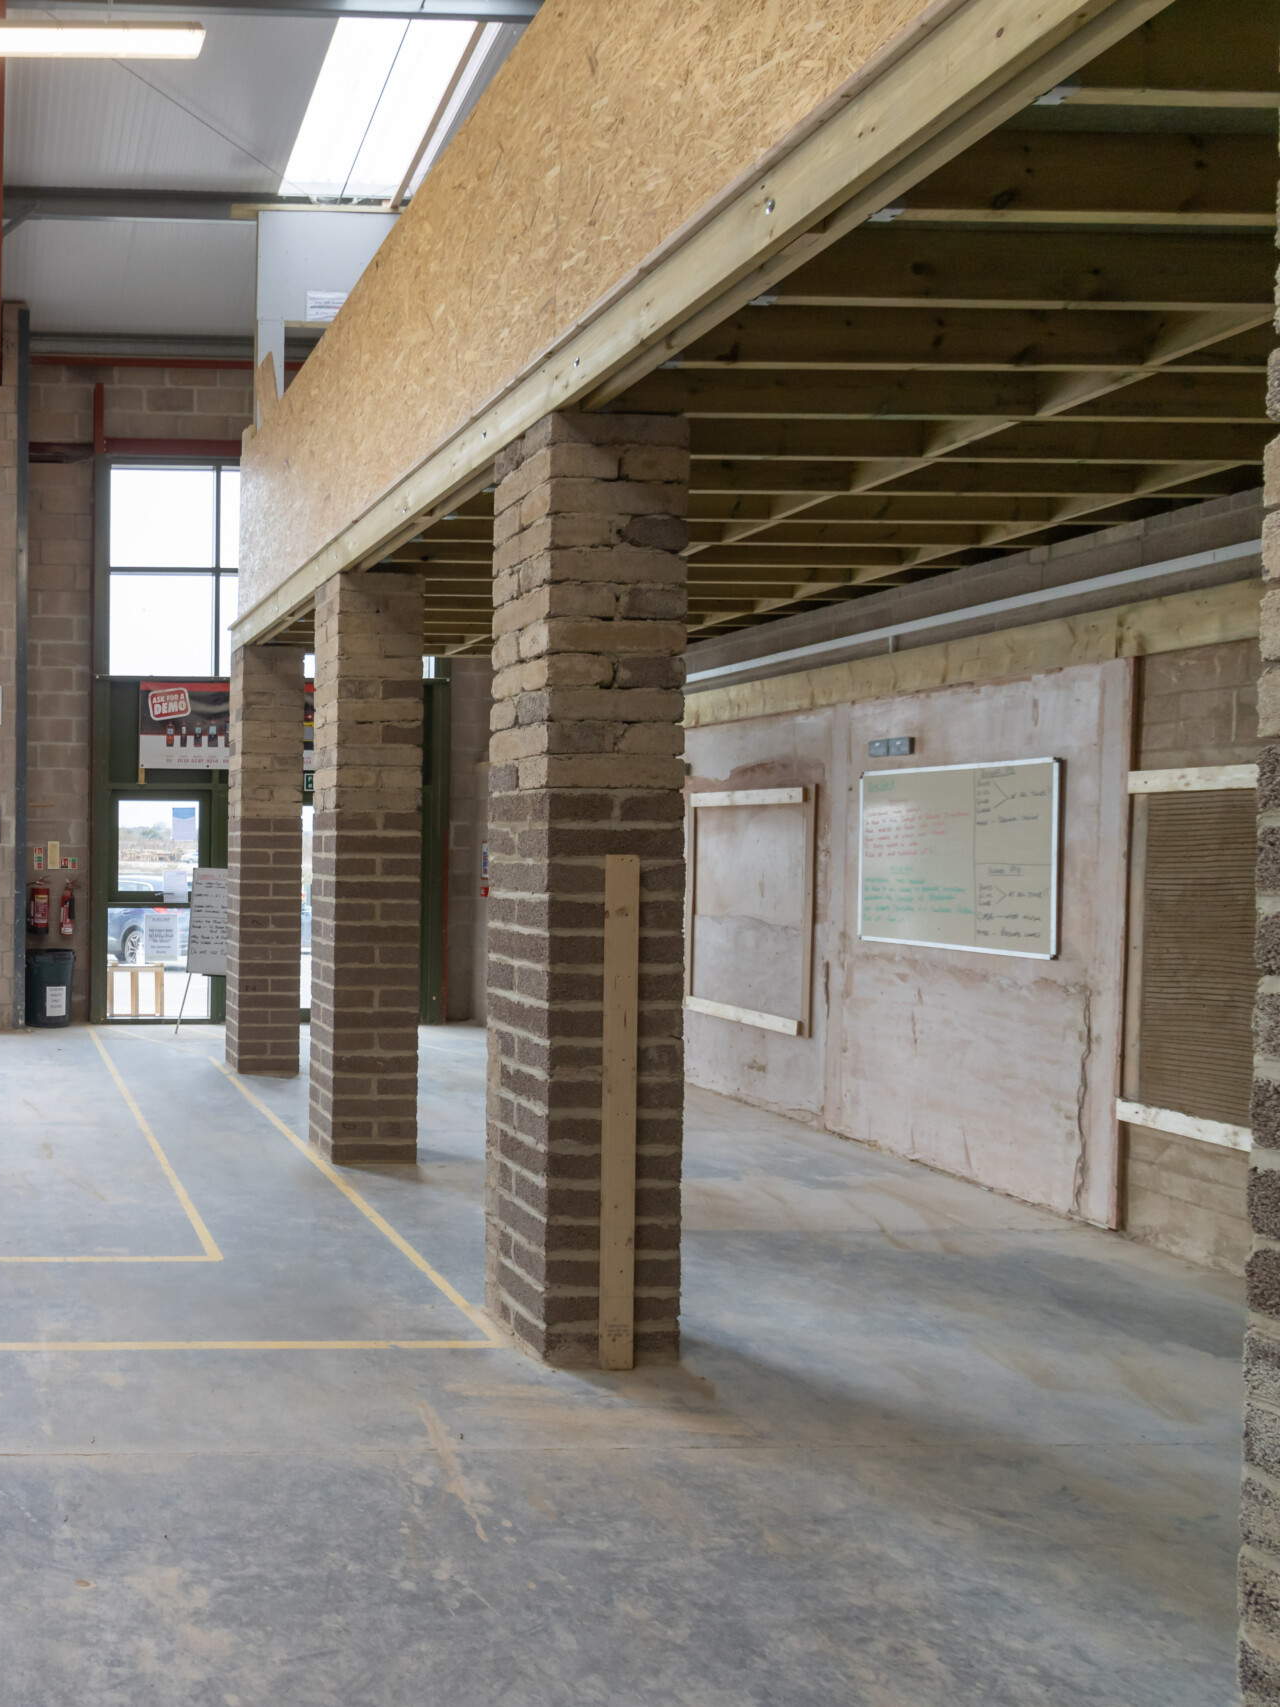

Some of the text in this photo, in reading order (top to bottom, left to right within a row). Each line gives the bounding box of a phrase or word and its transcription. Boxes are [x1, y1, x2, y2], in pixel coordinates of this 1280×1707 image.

[153, 696, 165, 704] ASK
[167, 694, 179, 702] FOR
[154, 700, 186, 715] DEMO
